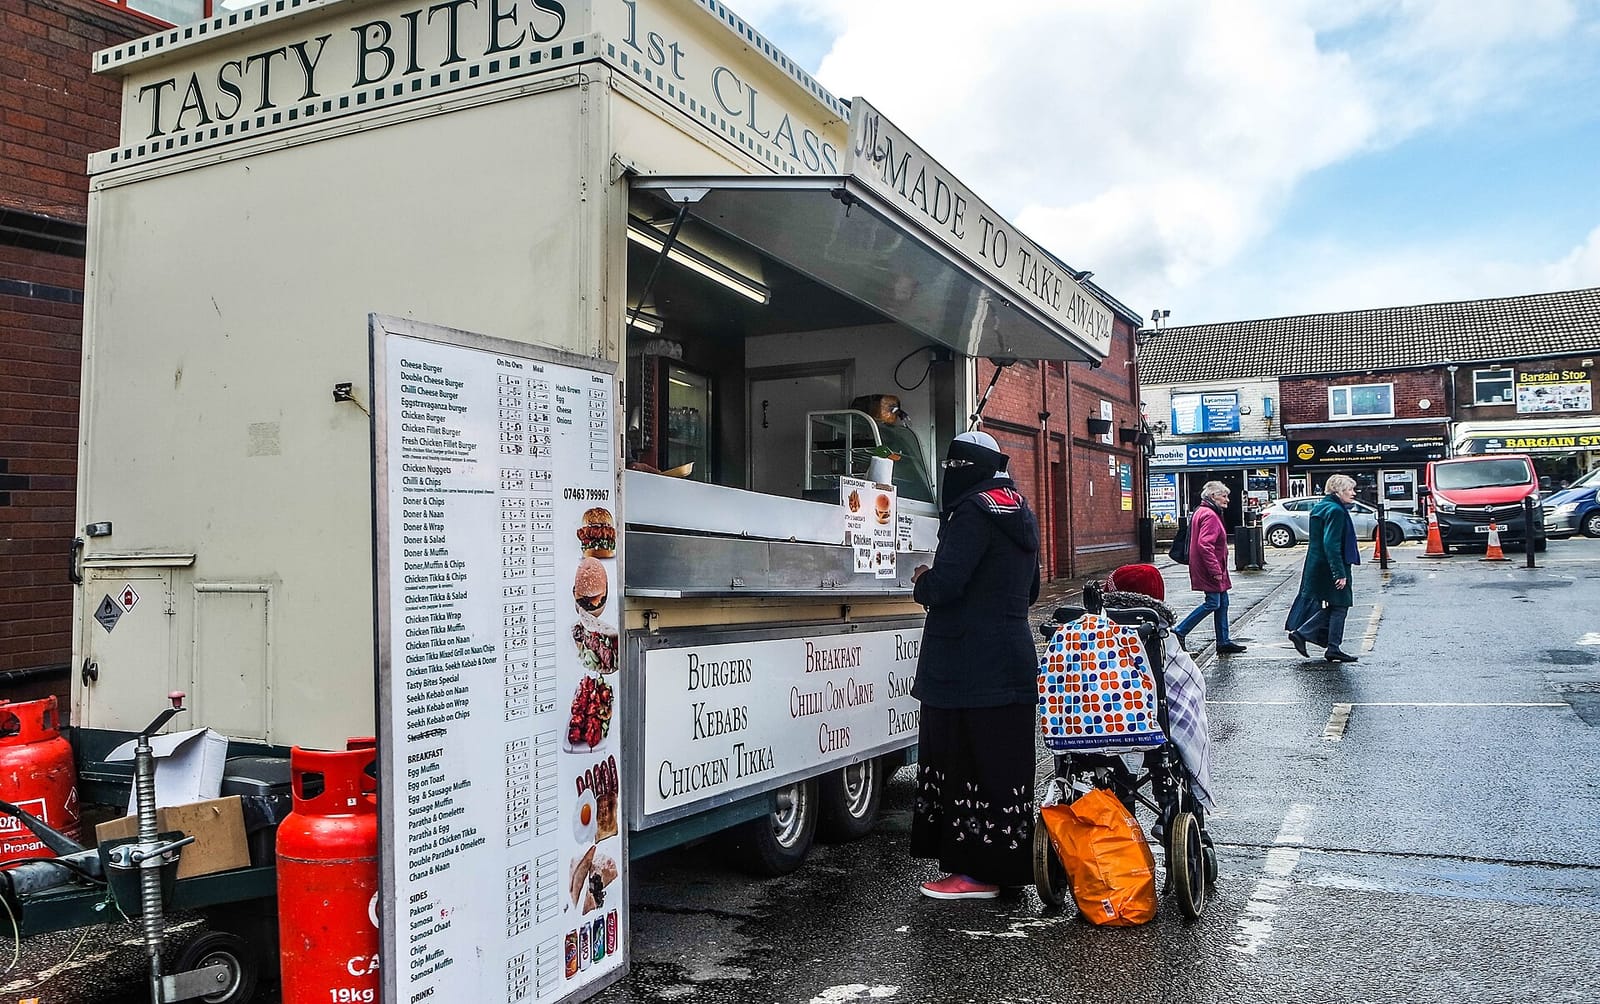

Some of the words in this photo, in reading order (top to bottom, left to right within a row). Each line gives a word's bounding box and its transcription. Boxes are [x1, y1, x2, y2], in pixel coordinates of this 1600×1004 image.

[139, 34, 332, 139] TASTY
[350, 0, 566, 88] BITES
[622, 0, 685, 80] 1st
[711, 66, 838, 175] CLASS
[881, 136, 967, 240] MADE
[978, 214, 1008, 268] TO
[1017, 247, 1062, 312] TAKE
[1066, 291, 1103, 342] AWAY
[1520, 372, 1559, 383] Bargain
[1562, 370, 1586, 380] Stop
[556, 396, 565, 404] Egg
[556, 406, 572, 414] Cheese
[1326, 444, 1353, 454] Akif
[1356, 442, 1400, 454] Styles
[1505, 437, 1576, 448] BARGAIN
[1157, 449, 1184, 459] mobile
[1189, 444, 1284, 458] CUNNINGHAM
[564, 488, 585, 501] 07463
[586, 489, 609, 501] 799967
[854, 534, 871, 546] Chicken
[888, 671, 914, 699] SAMO
[888, 707, 920, 736] PAKOR
[408, 748, 443, 764] BREAKFAST
[408, 769, 419, 778] Egg
[421, 763, 440, 774] Muffin
[408, 782, 420, 791] Egg
[429, 774, 445, 784] Toast
[408, 795, 420, 804] Egg
[428, 786, 452, 798] Sausage
[453, 780, 471, 791] Muffin
[409, 804, 433, 816] Sausage
[435, 797, 453, 809] Muffin
[409, 817, 432, 829] Paratha
[438, 808, 464, 820] Omelette
[409, 843, 432, 856] Paratha
[439, 834, 461, 845] Chicken
[462, 828, 477, 838] Tikka
[409, 856, 431, 869] Double
[432, 848, 454, 861] Paratha
[460, 838, 485, 851] Omelette
[409, 871, 428, 882] Chana
[435, 863, 450, 873] Naan
[410, 891, 428, 904] SIDES
[410, 903, 433, 917] Pakoras
[410, 916, 433, 930] Samosa
[410, 929, 433, 943] Samosa
[434, 920, 451, 933] Chaat
[410, 944, 427, 956] Chips
[411, 958, 424, 969] Chip
[425, 949, 444, 963] Muffin
[411, 968, 433, 982] Samosa
[435, 958, 453, 971] Muffin
[330, 988, 374, 1004] 19kg
[410, 987, 434, 1004] DRINKS
